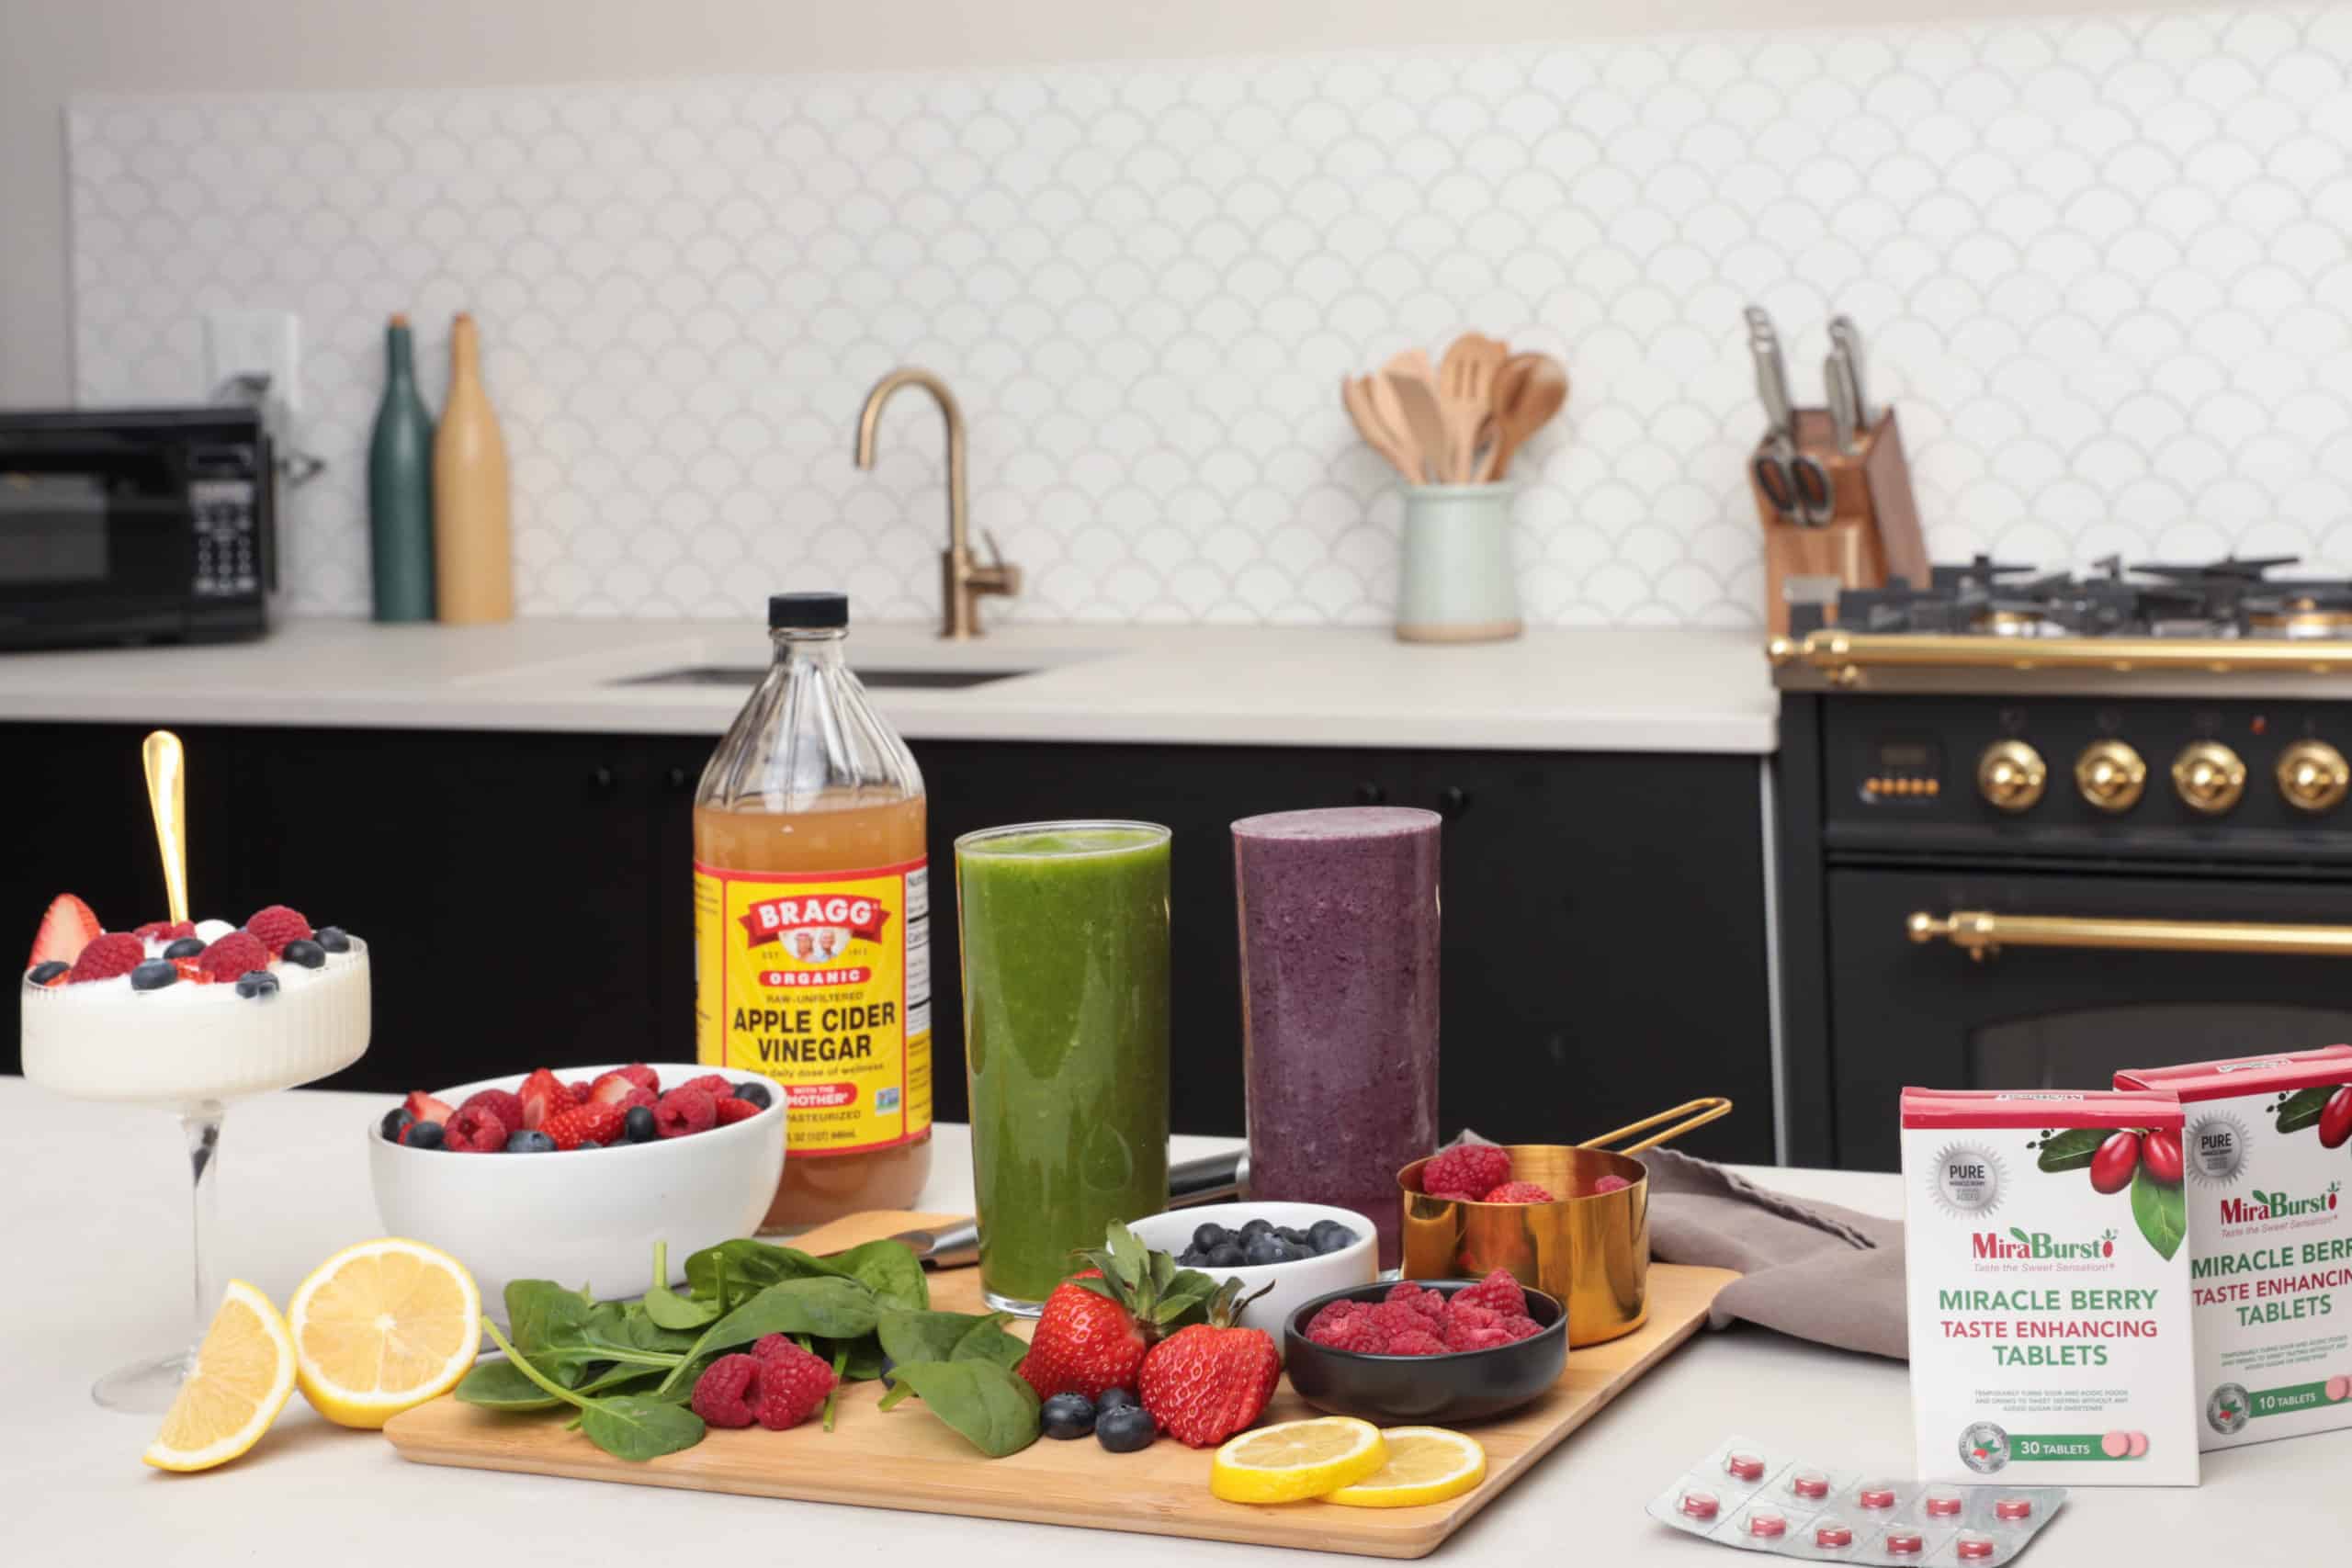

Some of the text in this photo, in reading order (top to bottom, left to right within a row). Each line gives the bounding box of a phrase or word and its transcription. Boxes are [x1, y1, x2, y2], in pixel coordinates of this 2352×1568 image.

[758, 898, 873, 929] BRAGG
[769, 969, 861, 986] ORGANIC
[734, 1008, 811, 1033] APPLE
[821, 1001, 896, 1032] CIDER
[757, 1034, 871, 1063] VINEGAR
[2201, 1133, 2232, 1150] PURE
[1949, 1165, 1984, 1179] PURE
[2221, 1192, 2326, 1225] MiraBurst
[1972, 1232, 2102, 1259] MiraBurst
[1974, 1263, 1999, 1272] Taste
[2002, 1263, 2018, 1272] the
[2021, 1263, 2052, 1272] Sweet
[2191, 1247, 2294, 1280] MIRACLE
[2193, 1269, 2352, 1306] TASTE ENHANCIN
[1939, 1289, 2158, 1311] MIRACLE BERRY
[2236, 1294, 2332, 1326] TABLETS
[1940, 1320, 2158, 1338] TASTE ENHANCING
[1992, 1344, 2108, 1366] TABLETS
[2259, 1393, 2316, 1410] 10 TABLETS
[2020, 1441, 2091, 1455] 30 TABLETS
